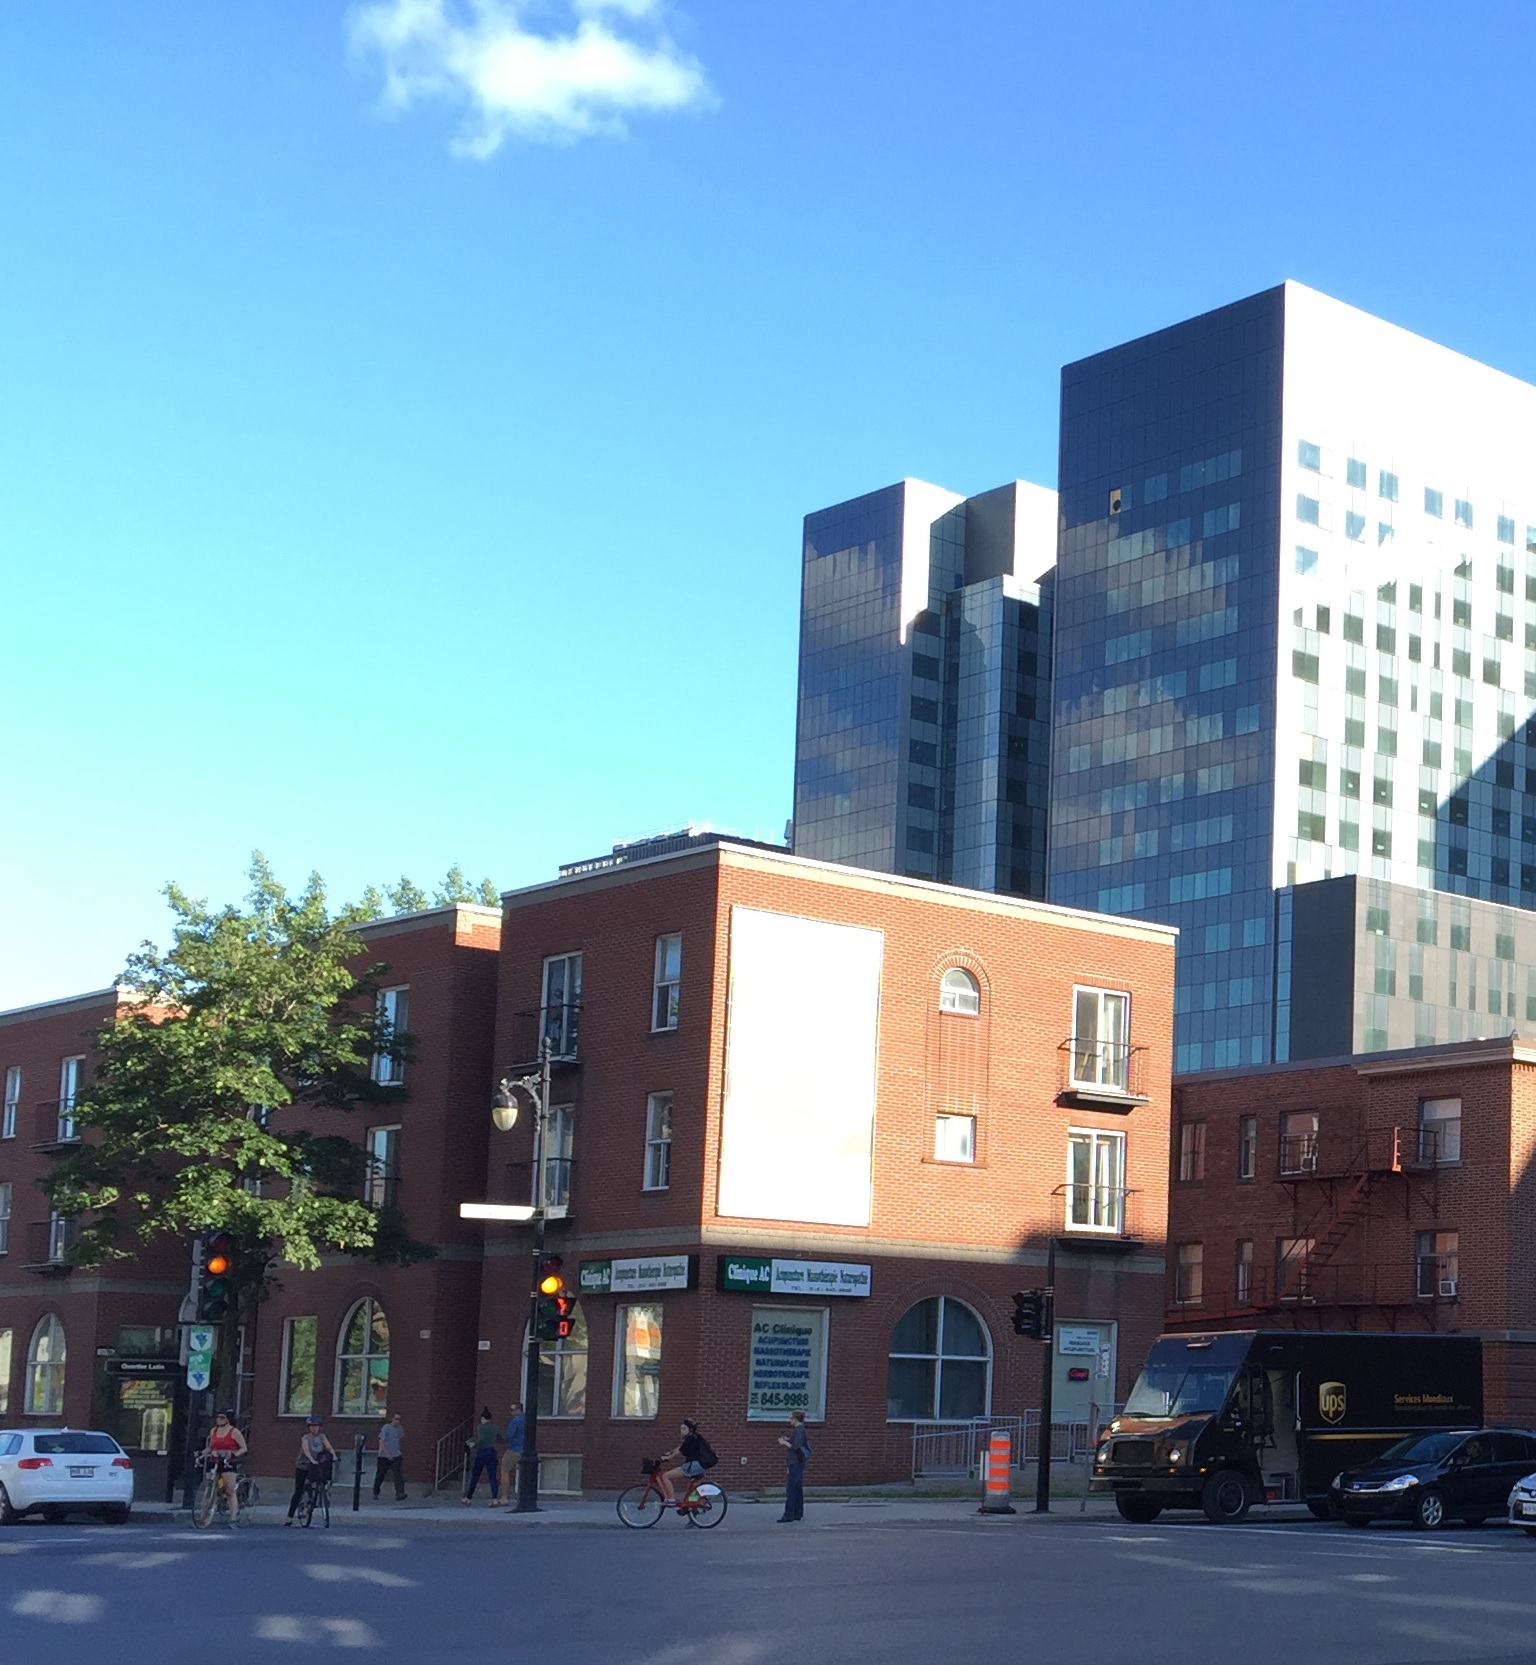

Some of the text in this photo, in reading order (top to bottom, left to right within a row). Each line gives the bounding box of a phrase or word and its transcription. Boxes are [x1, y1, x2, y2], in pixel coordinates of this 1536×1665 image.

[728, 1263, 770, 1285] Clinique AC
[753, 1323, 813, 1336] AC Clinique
[760, 1392, 809, 1406] 845-9988
[1322, 1394, 1344, 1418] ups
[1394, 1394, 1454, 1404] Services Mondiaux
